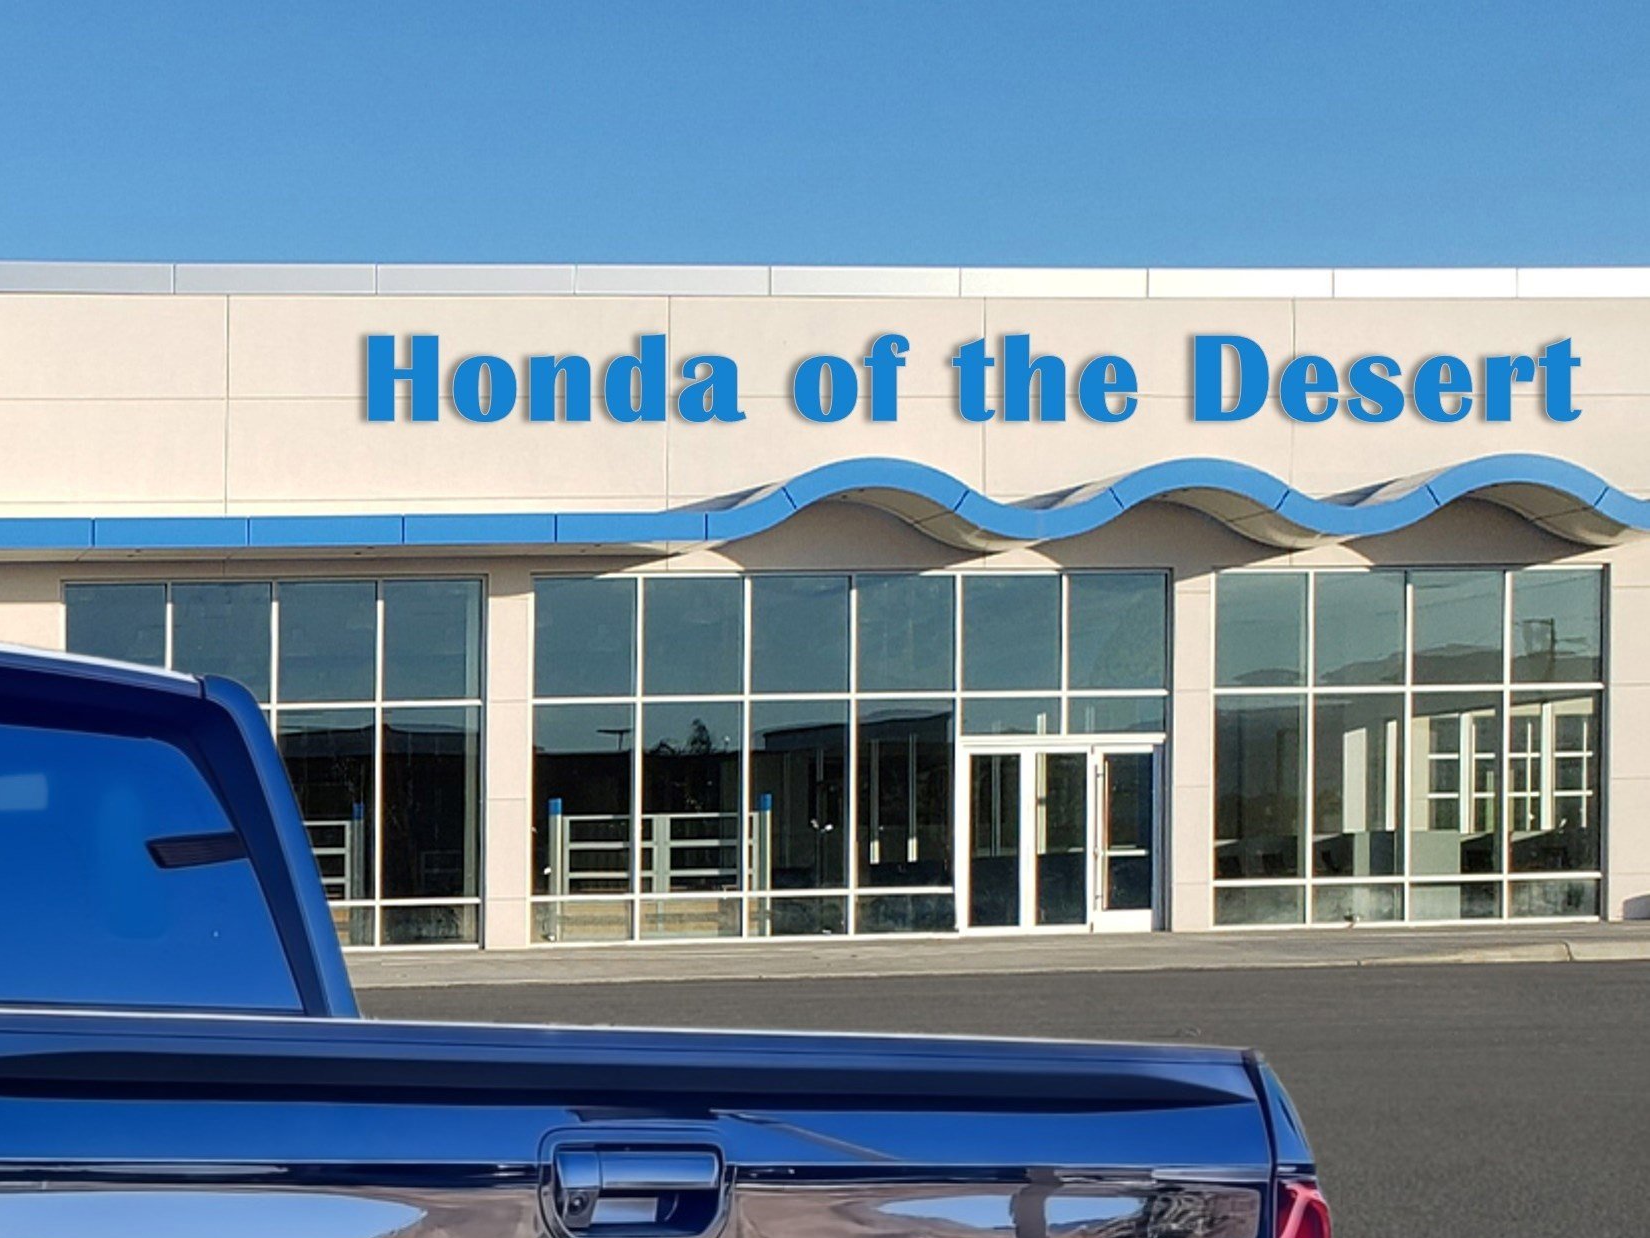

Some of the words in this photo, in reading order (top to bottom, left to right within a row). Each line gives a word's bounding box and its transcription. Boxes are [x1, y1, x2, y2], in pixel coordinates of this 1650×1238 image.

[366, 333, 748, 424] Honda
[793, 333, 911, 423] of
[951, 333, 1139, 423] the
[1193, 334, 1583, 424] Desert
